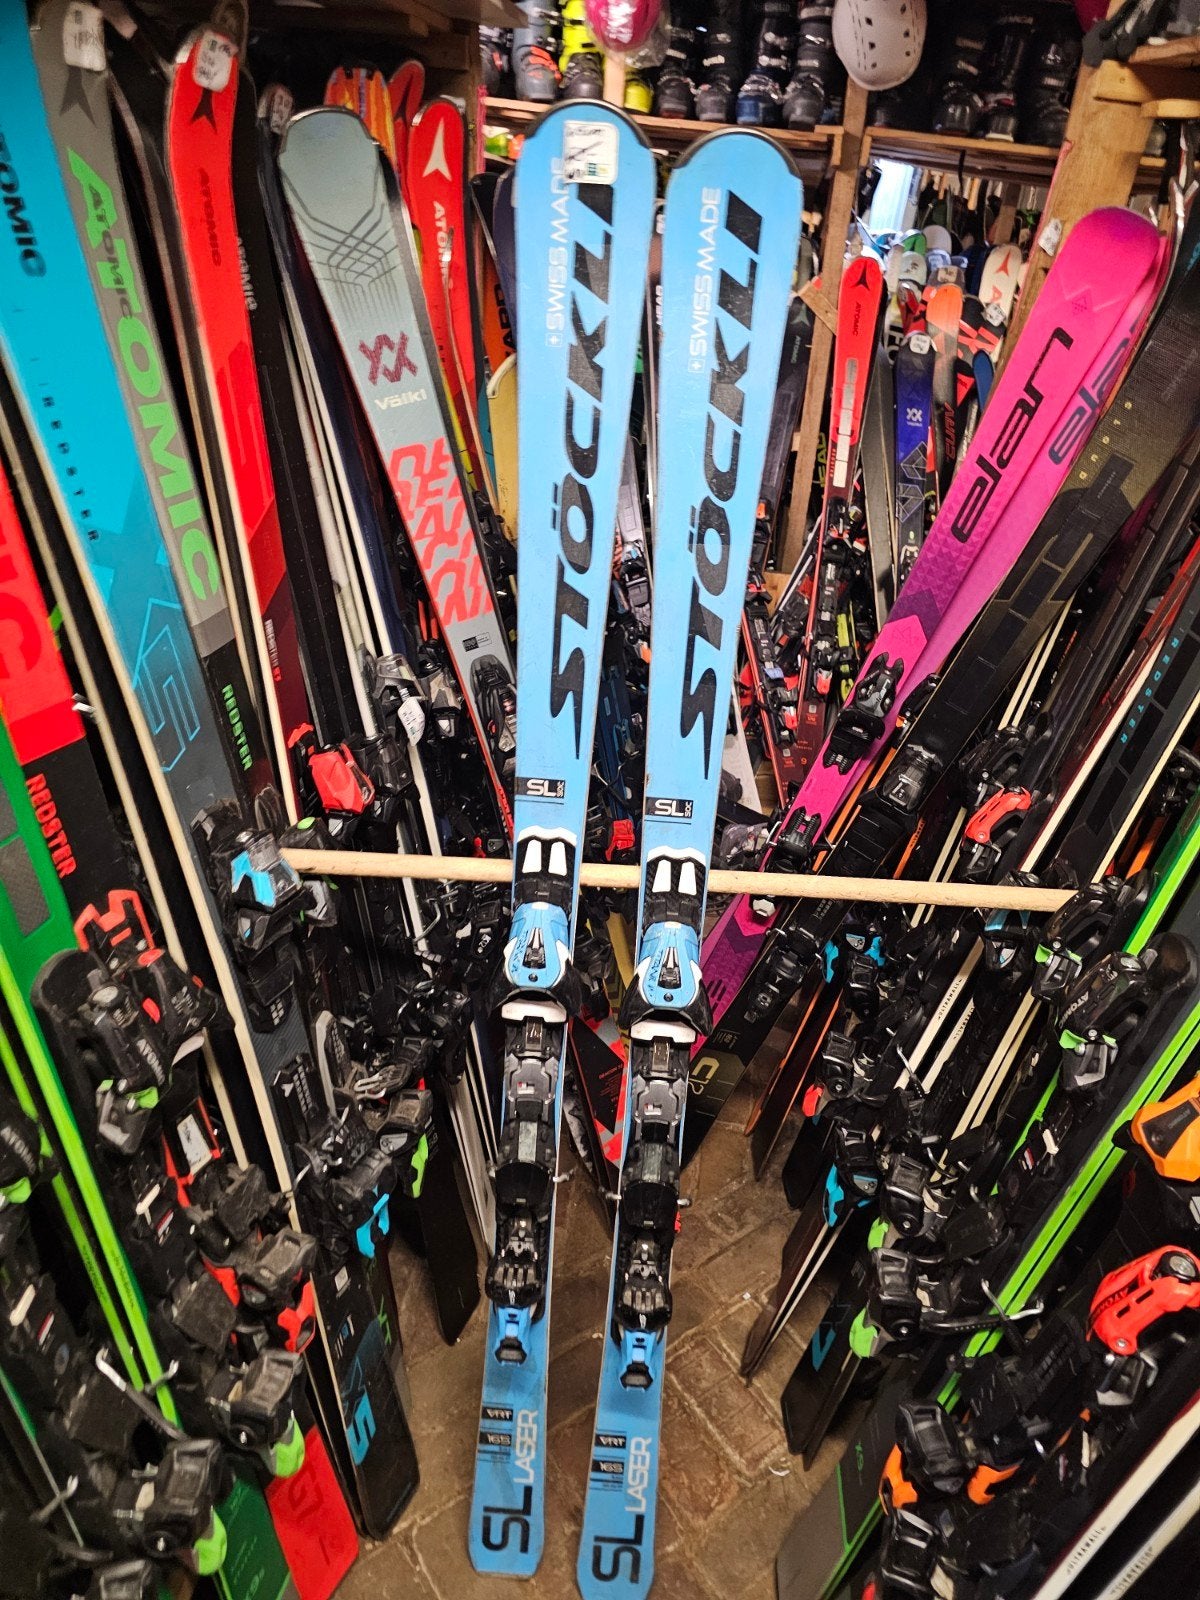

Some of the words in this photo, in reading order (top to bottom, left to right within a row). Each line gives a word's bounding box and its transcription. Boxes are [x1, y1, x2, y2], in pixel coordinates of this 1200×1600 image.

[88, 184, 134, 320] ATOMIC
[199, 167, 222, 267] ATOMIC
[699, 186, 722, 271] MADE
[547, 249, 569, 331] SWISS
[690, 272, 712, 356] SWISS
[852, 301, 861, 337] ATOMIC
[67, 146, 219, 600] ATOMIC
[790, 335, 801, 365] ATOMIC
[550, 183, 615, 761] STÖCKLI
[950, 326, 1075, 544] elan
[1079, 401, 1133, 481] CLOUD
[680, 189, 763, 781] STÖCKLI
[222, 683, 253, 771] REDSTER
[1119, 637, 1180, 744] REDSTER
[26, 772, 77, 879] REDSTER
[526, 778, 557, 797] SL
[654, 799, 684, 817] SL
[1059, 990, 1089, 1029] ATOMIC
[136, 1038, 166, 1087] ATOMIC
[482, 1485, 533, 1554] SL
[513, 1409, 539, 1485] LASER
[591, 1513, 645, 1585] SL
[624, 1436, 652, 1513] LASER
